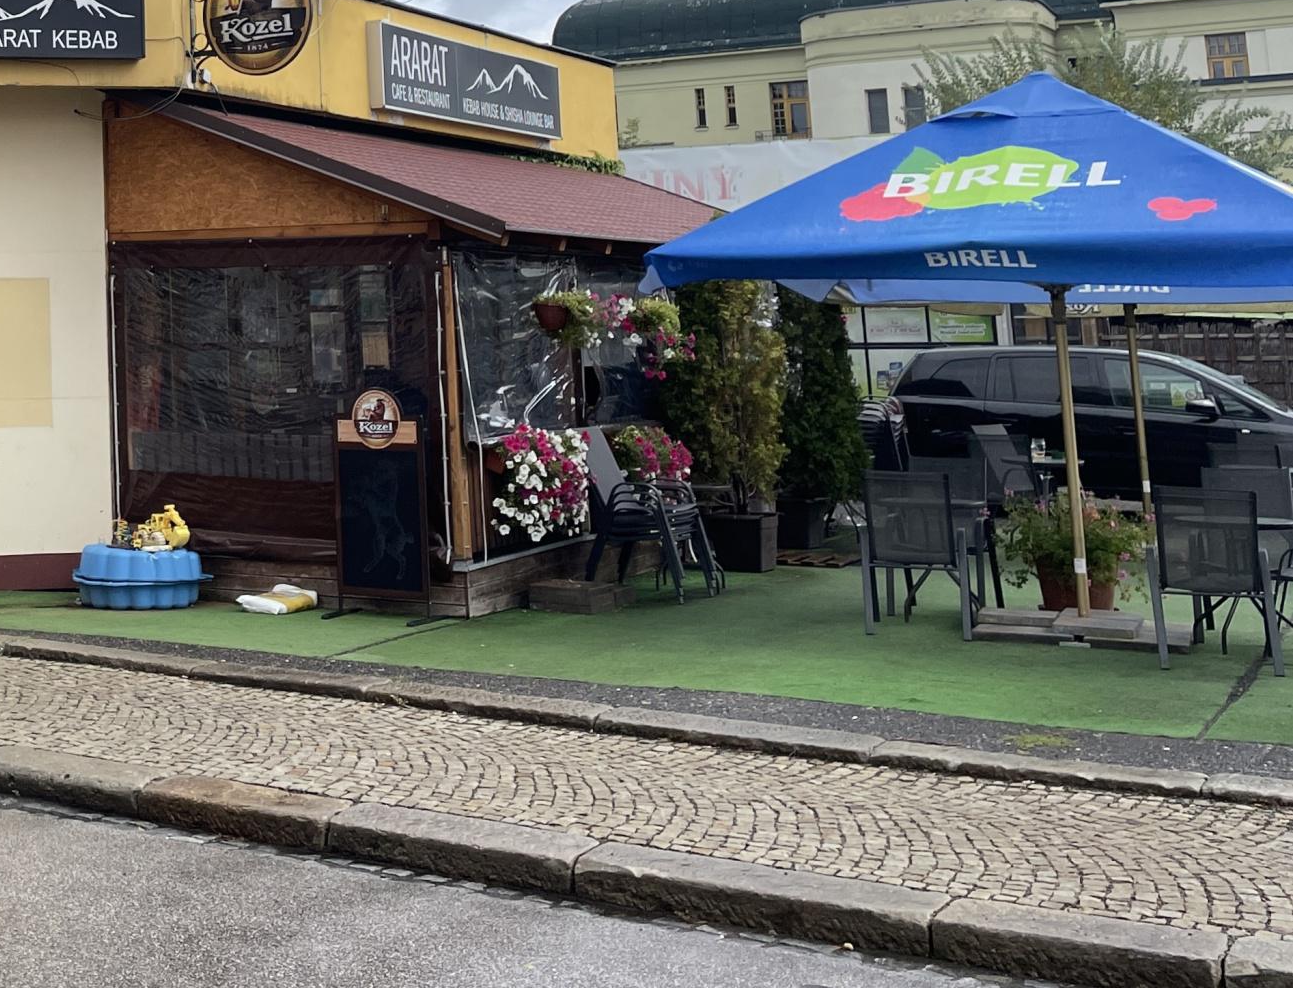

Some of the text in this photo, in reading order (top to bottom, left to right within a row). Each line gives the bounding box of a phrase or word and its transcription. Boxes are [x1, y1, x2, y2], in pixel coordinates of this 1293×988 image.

[52, 30, 118, 49] KEBAB
[220, 13, 293, 43] Kozel
[247, 43, 268, 51] 1874
[391, 34, 448, 87] ARARAT
[408, 89, 413, 102] &
[414, 87, 450, 110] RESTAURANT
[463, 97, 554, 129] KEBAB HOUSE & SHISHA LOUNGE BAR
[882, 161, 1121, 198] BIRELL
[924, 249, 1036, 268] BIRELL
[359, 421, 393, 433] Kozel
